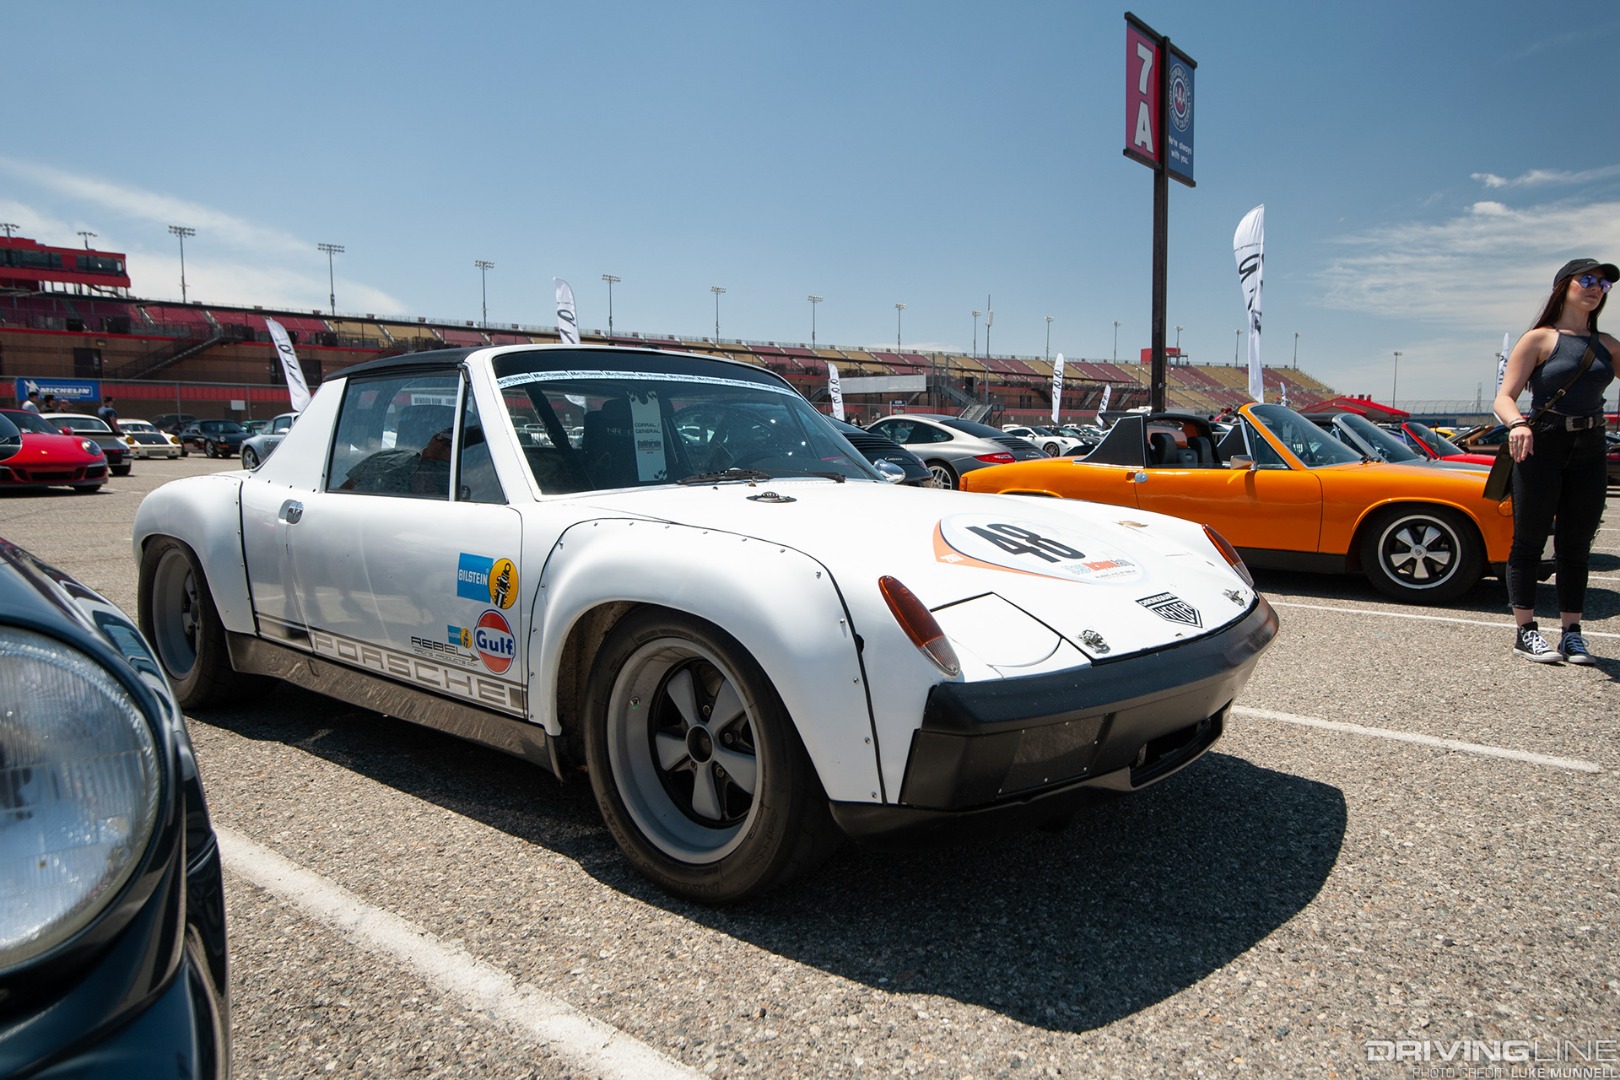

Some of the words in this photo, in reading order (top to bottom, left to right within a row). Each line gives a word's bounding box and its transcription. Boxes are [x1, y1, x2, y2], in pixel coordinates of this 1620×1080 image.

[1137, 42, 1153, 95] 7
[1134, 101, 1154, 154] A
[964, 523, 1086, 563] 48
[458, 569, 488, 586] BILSTEIN
[411, 636, 460, 656] REBEL
[476, 630, 513, 656] Gulf
[314, 631, 506, 706] PORSCHE
